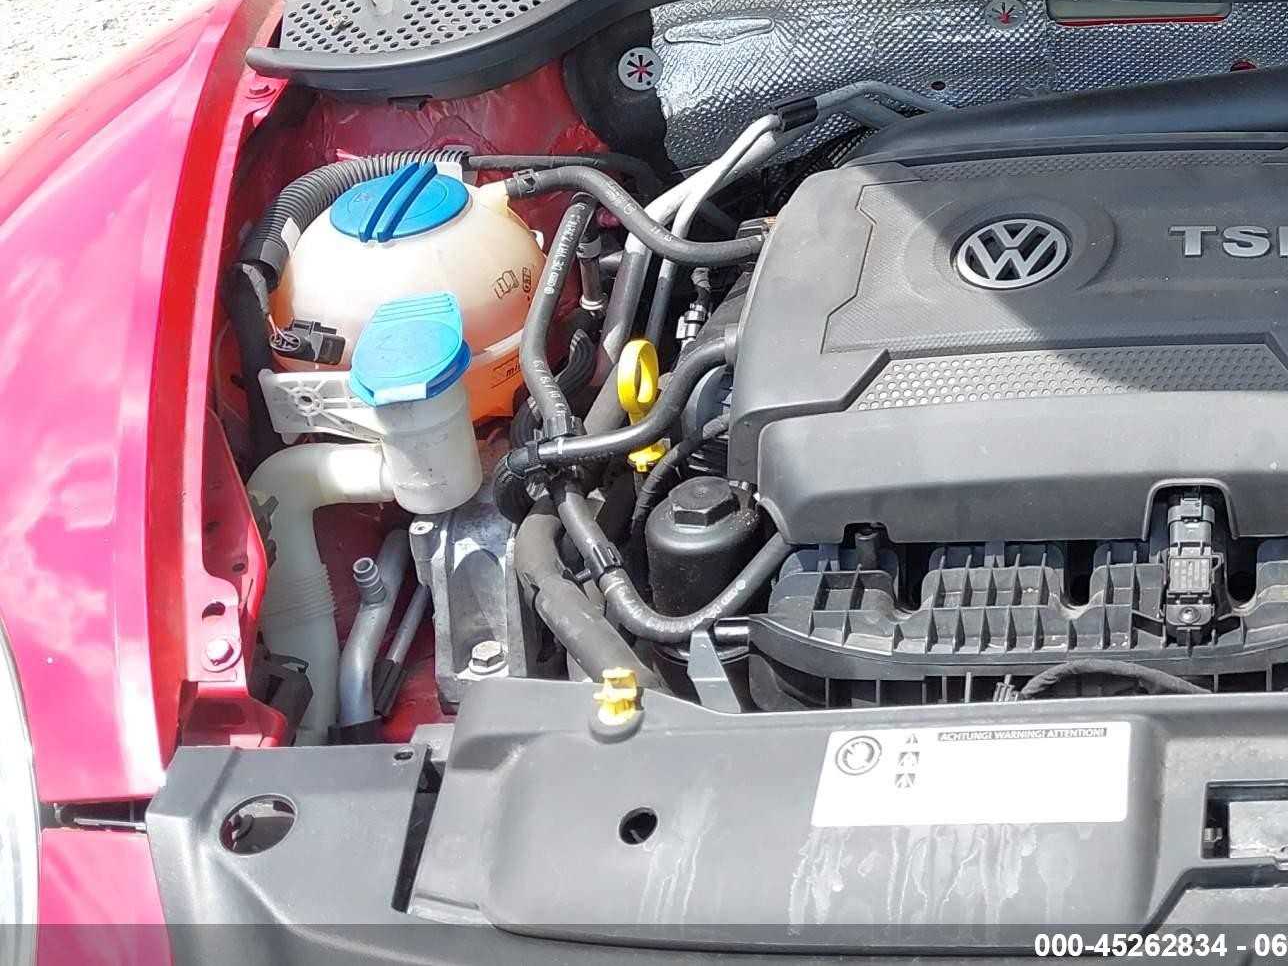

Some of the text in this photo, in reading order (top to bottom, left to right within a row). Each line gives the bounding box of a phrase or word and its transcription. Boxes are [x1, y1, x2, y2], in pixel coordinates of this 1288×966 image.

[939, 728, 1105, 741] ACHTUNG! WARNING! ATTENTION!
